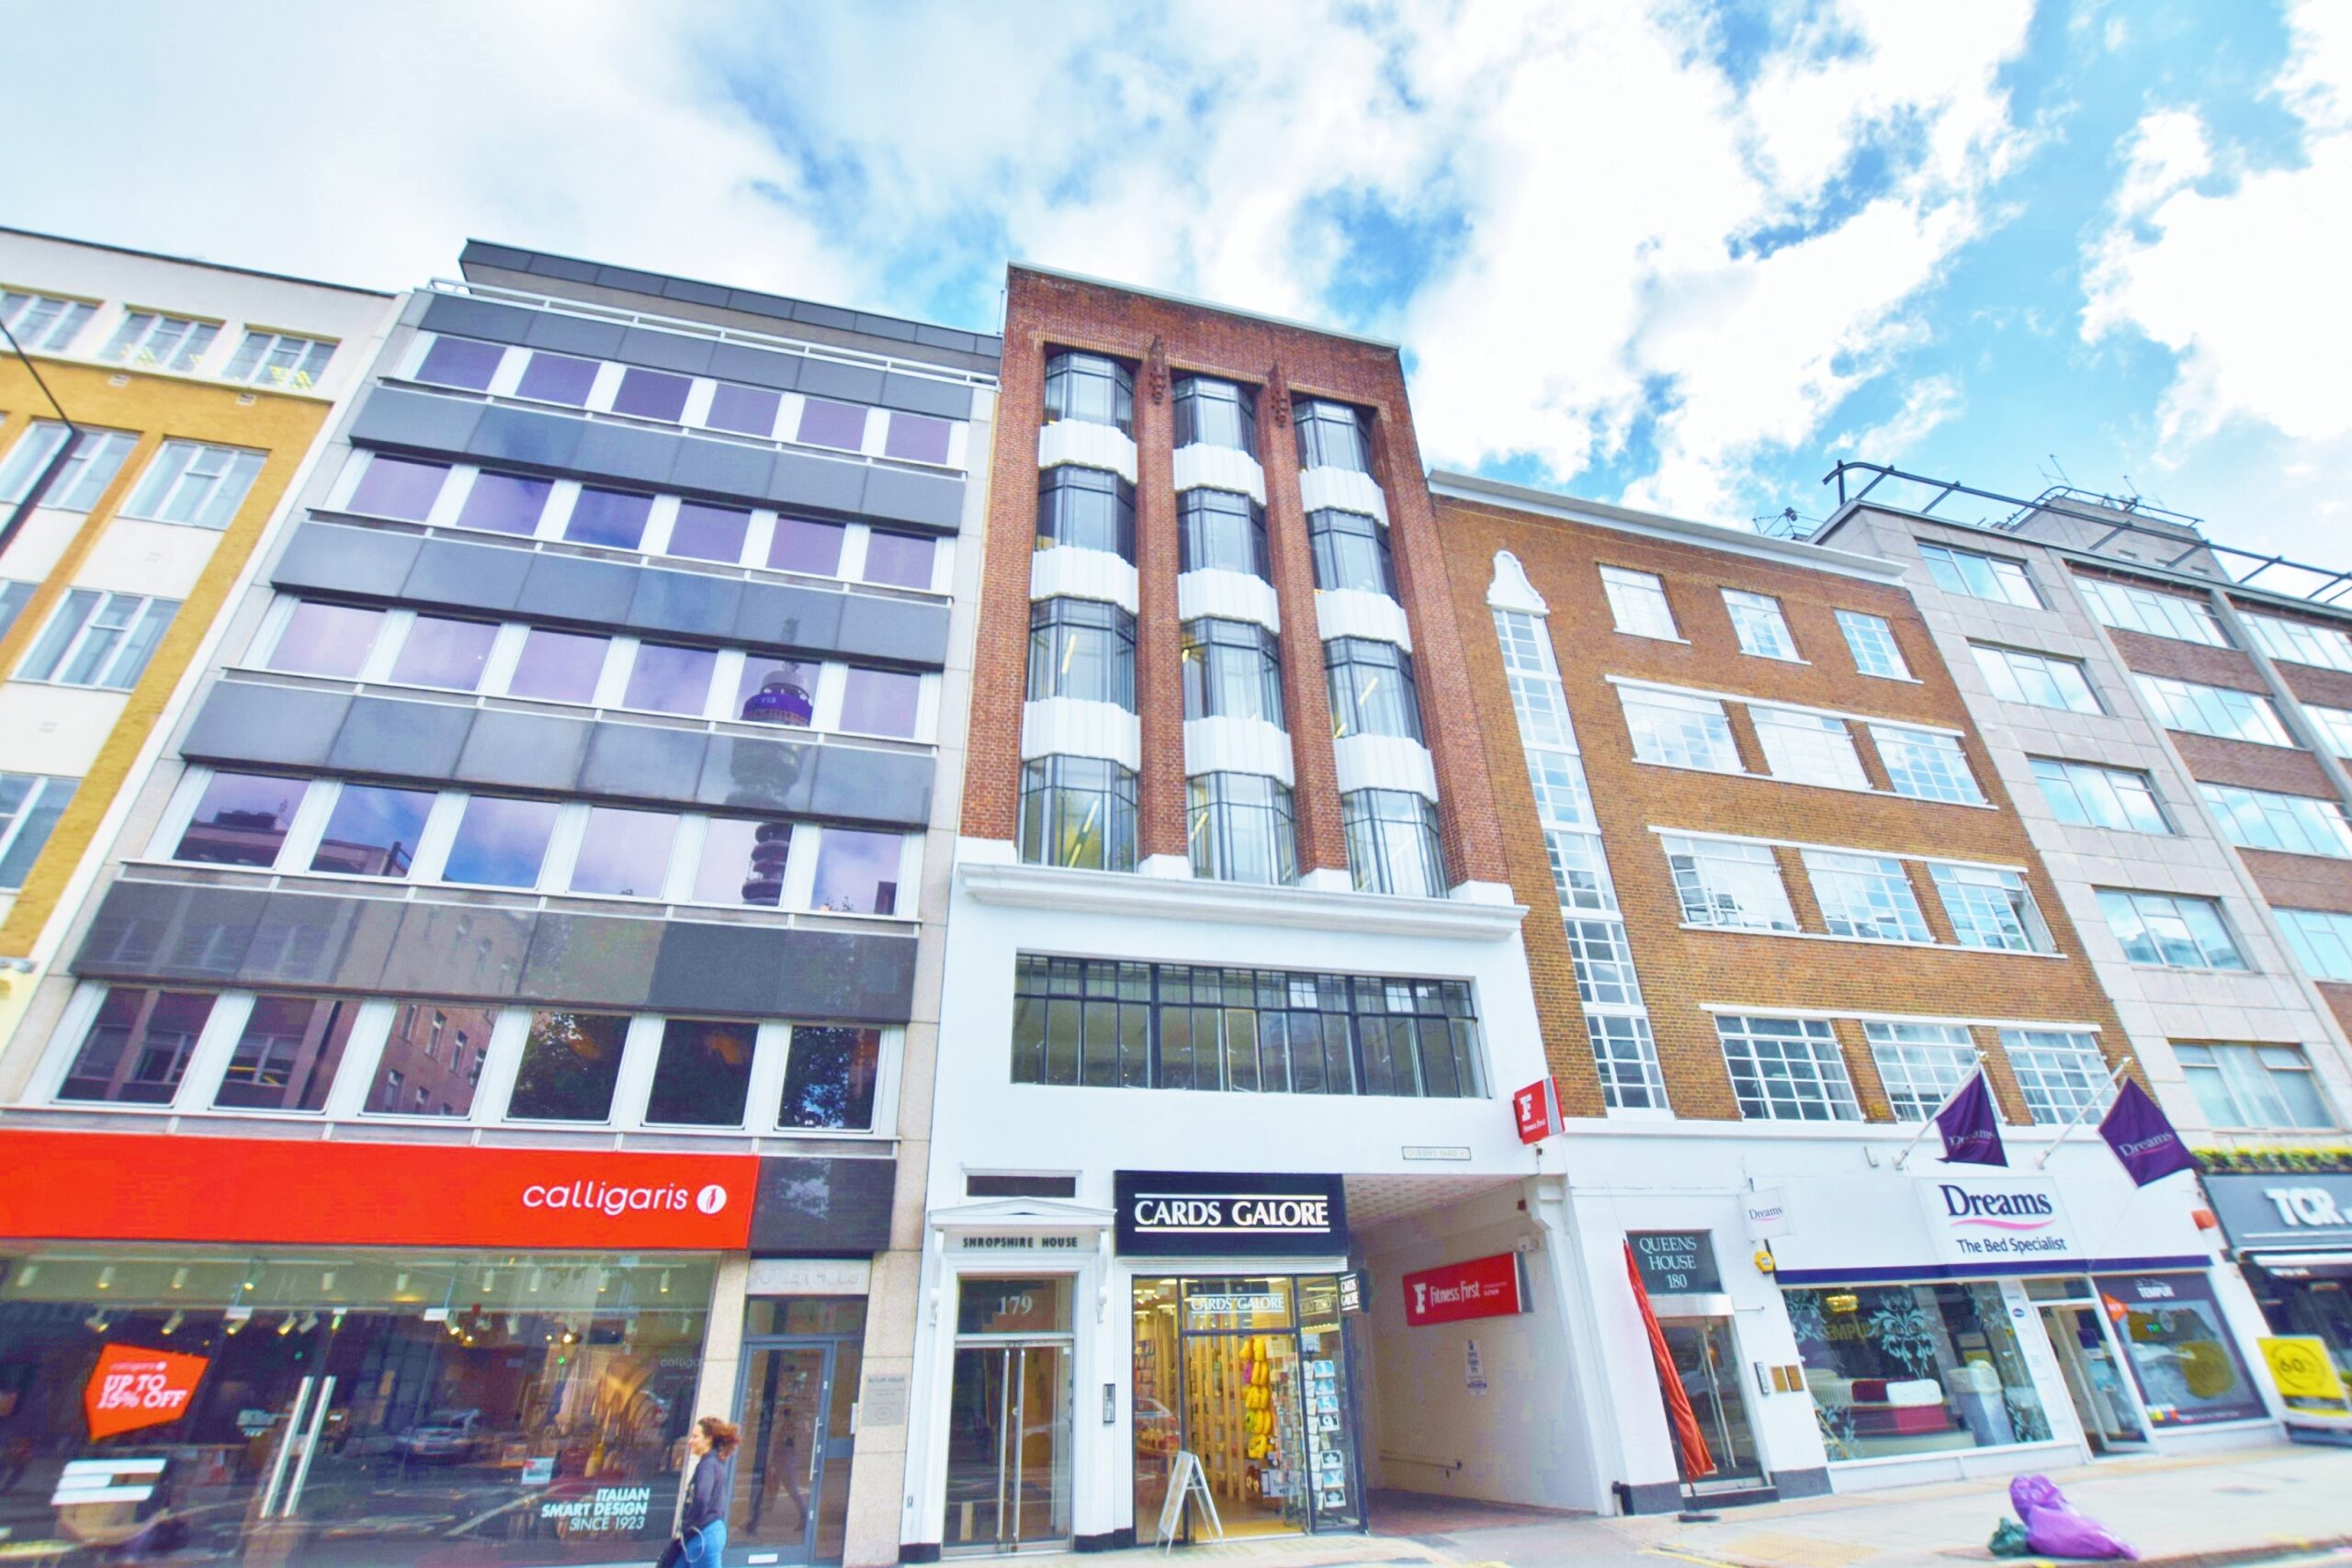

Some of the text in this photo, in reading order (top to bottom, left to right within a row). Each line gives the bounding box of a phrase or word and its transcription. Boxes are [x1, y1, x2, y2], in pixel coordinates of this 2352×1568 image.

[2118, 1133, 2174, 1157] Dreams
[523, 1180, 688, 1215] calligaris
[1938, 1184, 2052, 1216] Dreams
[1134, 1201, 1329, 1226] CARDS GALORE
[1748, 1206, 1783, 1220] Dreams
[2264, 1188, 2346, 1226] TCR
[963, 1237, 1078, 1248] SHROPSHIRE HOUSE
[1639, 1236, 1697, 1255] QUEENS
[1956, 1236, 2067, 1255] The Bed Specialist
[1648, 1255, 1697, 1270] HOUSE
[1340, 1279, 1357, 1294] CARDS
[1666, 1273, 1688, 1289] 180
[1341, 1292, 1359, 1306] GALORE
[2137, 1286, 2175, 1298] TEMPUR
[999, 1296, 1033, 1315] 179
[1191, 1297, 1232, 1311] CARDS
[1238, 1296, 1284, 1311] GALORE
[104, 1374, 167, 1393] UP TO
[143, 1390, 187, 1408] OFF
[596, 1488, 650, 1502] ITALIAN
[541, 1502, 648, 1517] SMART DESIGN
[570, 1516, 645, 1531] SINCE 1923
